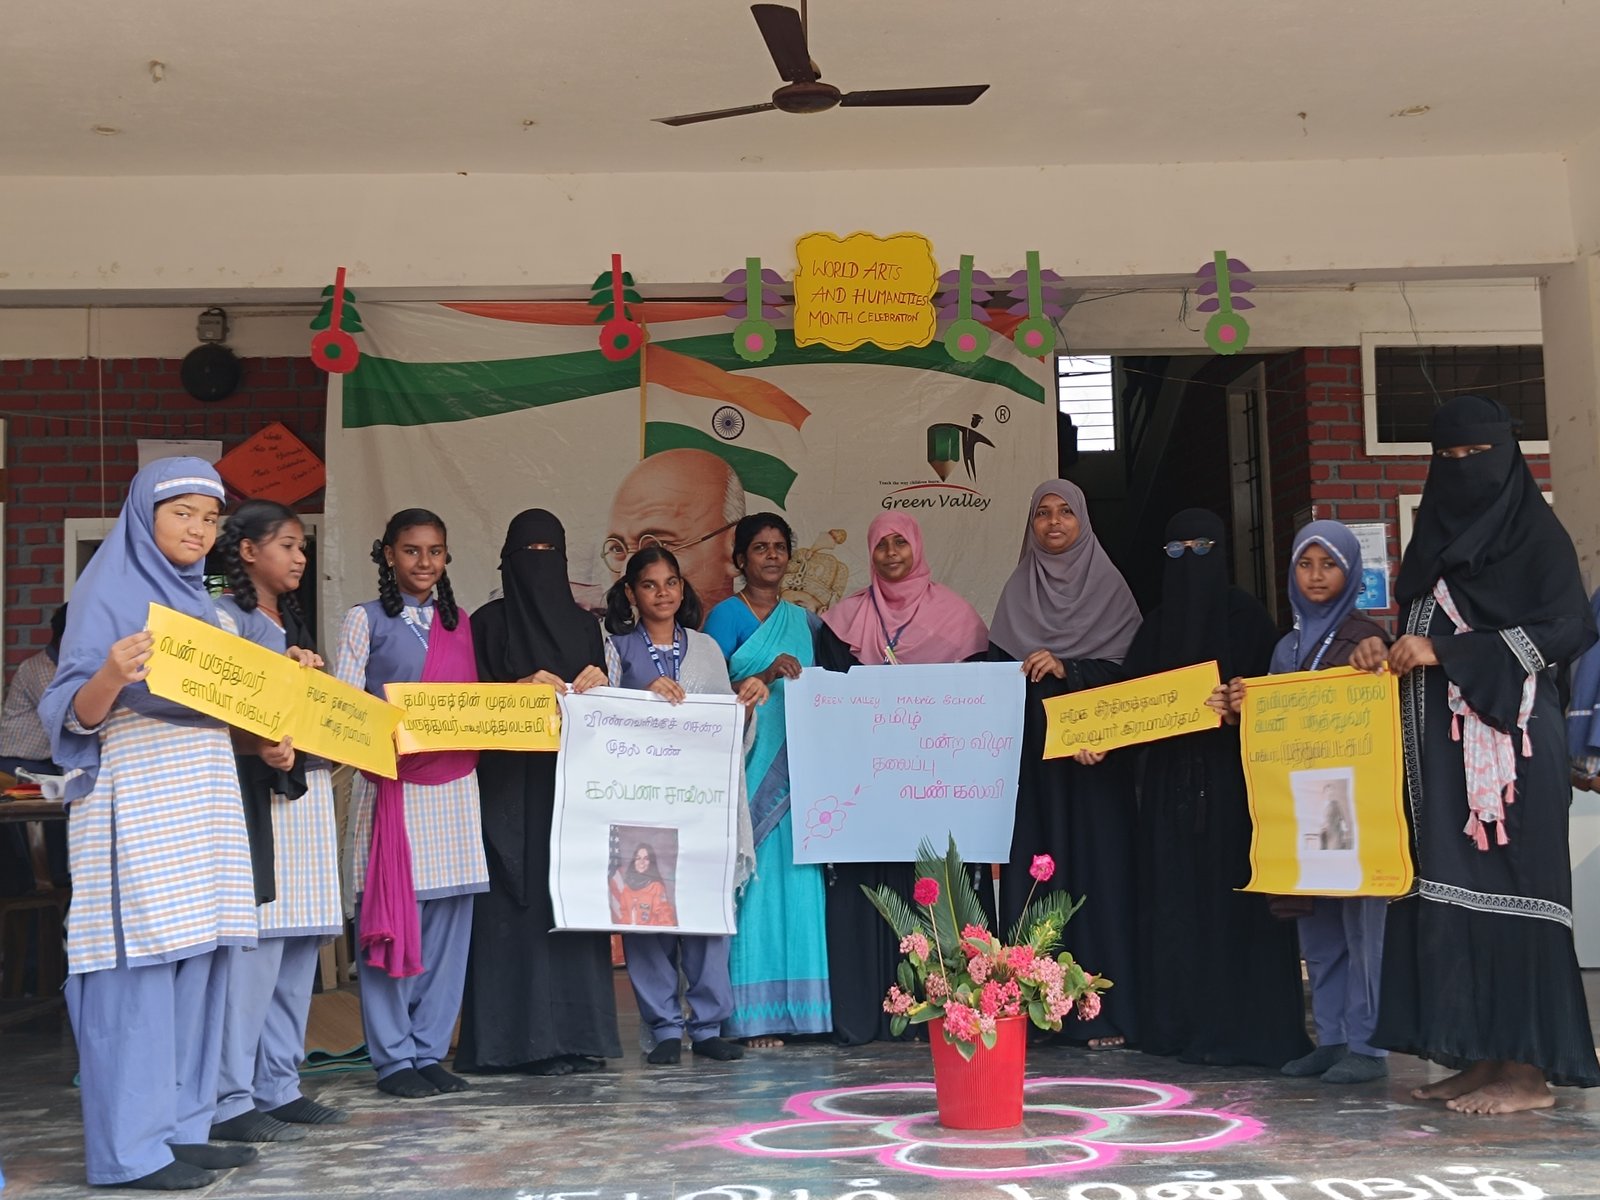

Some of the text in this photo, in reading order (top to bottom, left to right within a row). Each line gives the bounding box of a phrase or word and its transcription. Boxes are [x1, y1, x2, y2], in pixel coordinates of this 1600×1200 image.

[812, 259, 903, 281] WORLD ARTS
[811, 286, 929, 306] AND HUMANITIES
[808, 310, 920, 328] MONTH CELEBRATION
[881, 493, 991, 511] Green Valley
[160, 636, 266, 697] பெண் மருத்துவர்
[404, 691, 481, 712] தமிழகத்தின்
[519, 693, 550, 710] பெண்
[683, 719, 723, 737] சென்ற
[873, 707, 922, 734] தமிழ்
[606, 739, 681, 758] முதல் பெண்
[919, 731, 1014, 758] மன்ற விழா
[872, 755, 935, 779] தலைப்பு
[585, 780, 661, 800] கல்பனா
[900, 779, 950, 800] பெண்
